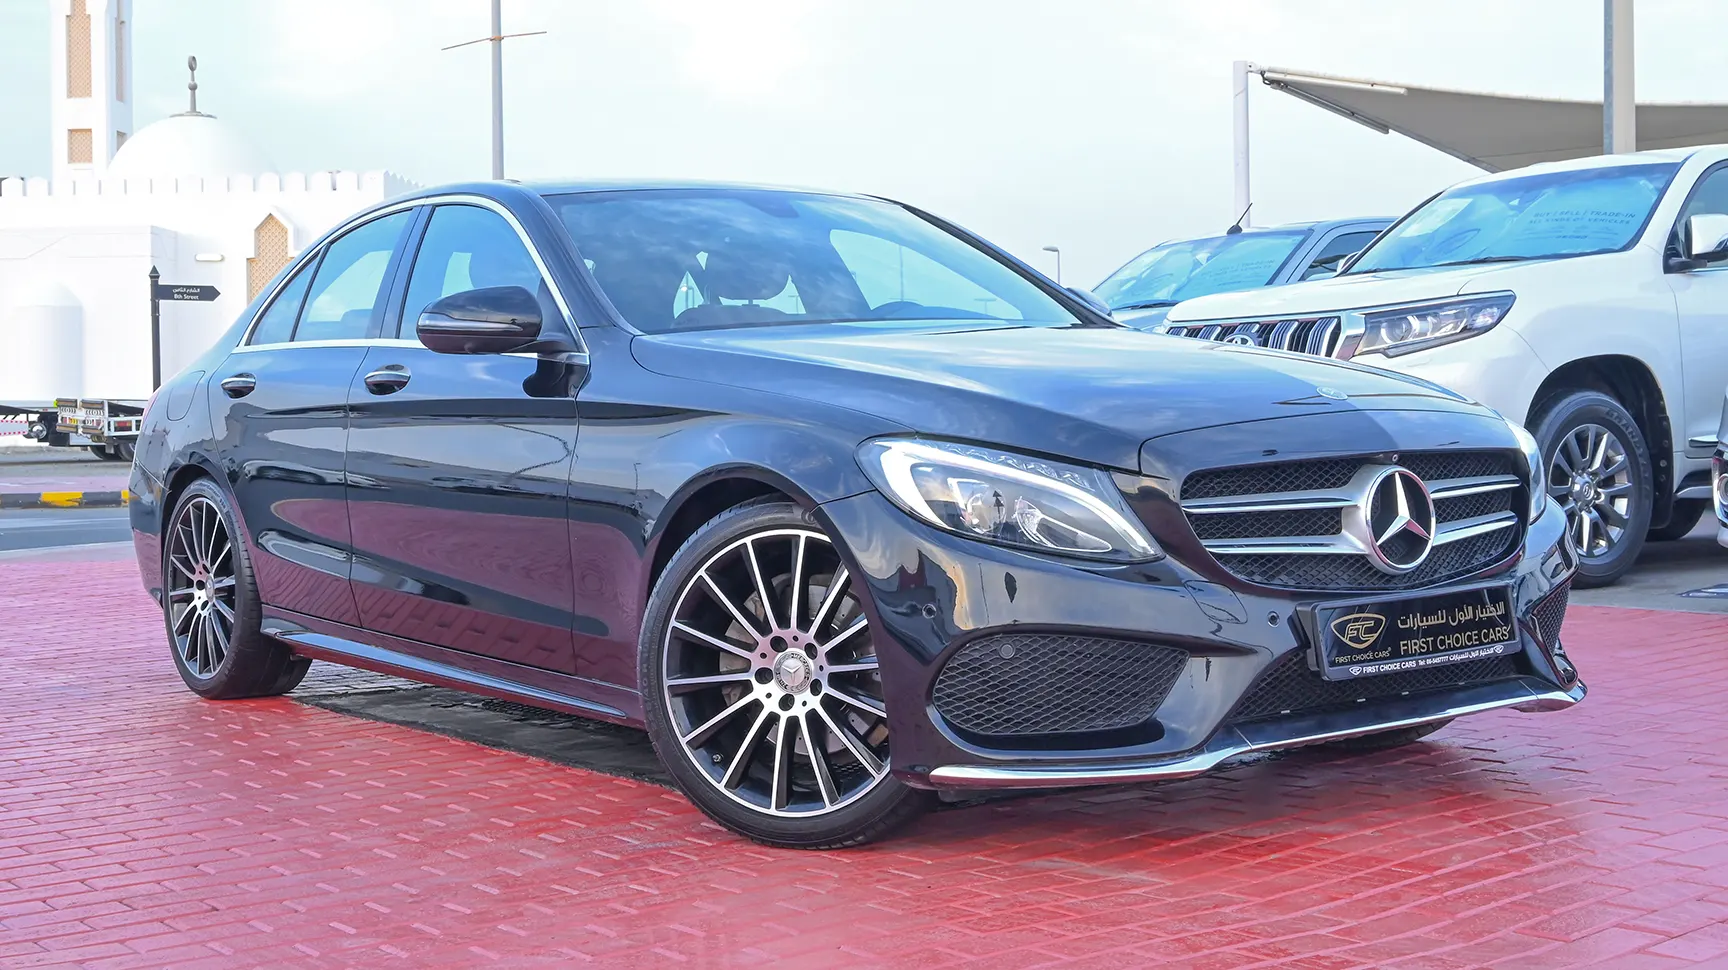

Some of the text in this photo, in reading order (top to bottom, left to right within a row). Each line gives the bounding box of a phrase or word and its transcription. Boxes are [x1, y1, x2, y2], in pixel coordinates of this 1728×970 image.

[1397, 601, 1505, 630] الاختيار الأول للسيارات
[1400, 626, 1509, 655] FIRST CHOICE CARS
[1335, 655, 1351, 664] FIRST
[1352, 652, 1374, 662] CHOICE
[1363, 665, 1379, 673] FIRST
[1380, 663, 1400, 671] CHOICE
[1401, 660, 1416, 668] CARS
